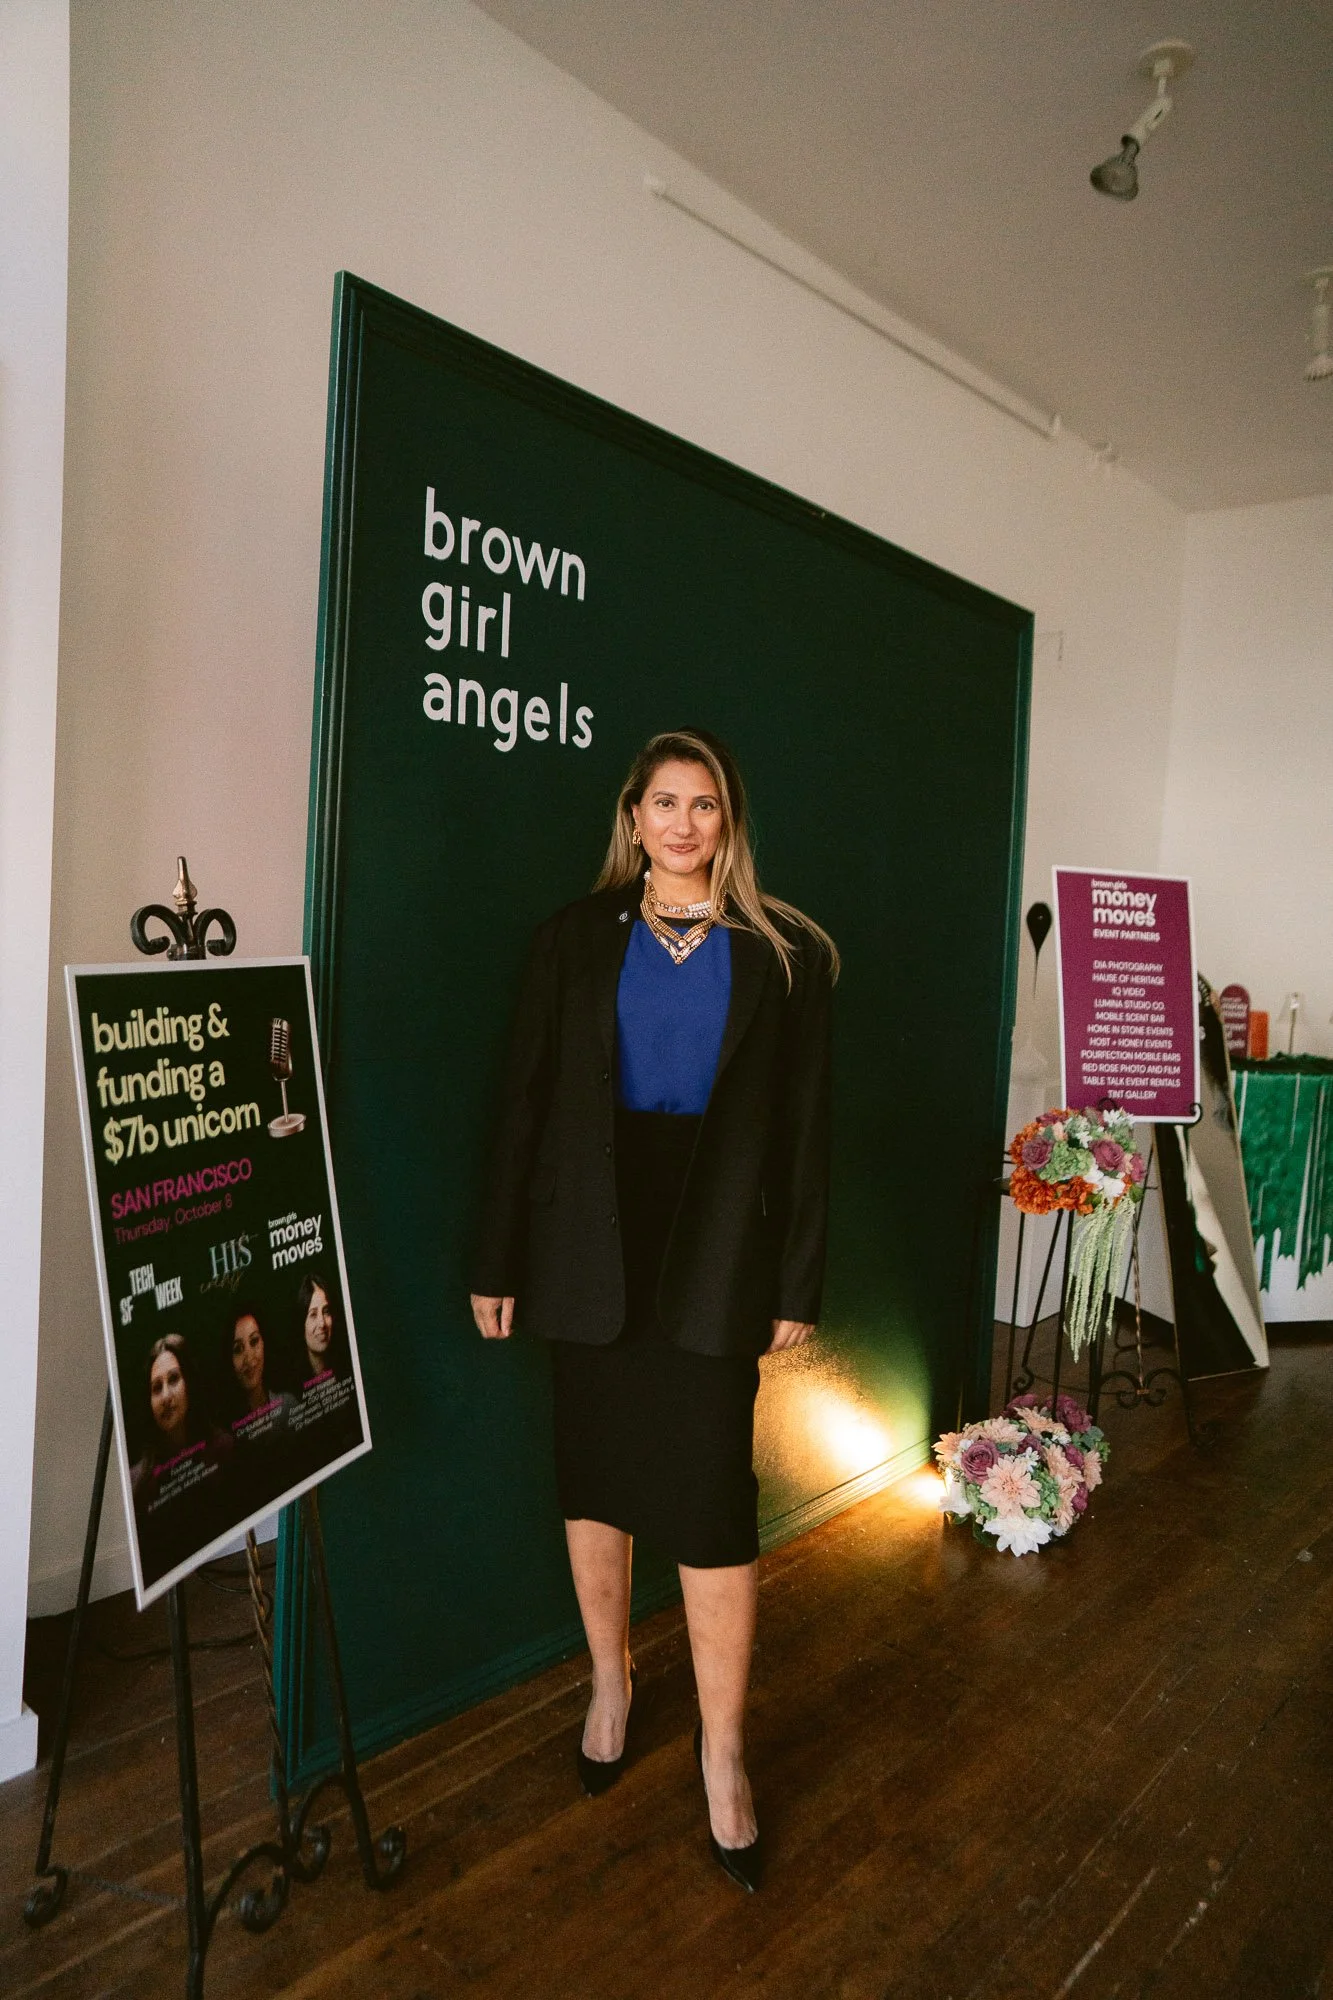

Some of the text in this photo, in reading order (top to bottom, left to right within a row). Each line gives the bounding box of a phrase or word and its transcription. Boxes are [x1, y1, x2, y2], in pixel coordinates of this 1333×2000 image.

[424, 486, 586, 601] brown
[421, 581, 511, 658] girl
[422, 672, 594, 752] angels
[1091, 889, 1157, 912] money
[1093, 907, 1156, 928] moves
[1093, 928, 1161, 942] EVENT PARTNERS
[1108, 961, 1163, 972] PHOTOGRAPHY
[1118, 974, 1130, 984] OF
[1131, 975, 1165, 986] HERITAGE
[1122, 987, 1146, 997] VIDEO
[1094, 998, 1123, 1009] LUMINA
[1124, 1000, 1151, 1010] STUDIO
[91, 1002, 230, 1053] building &
[1095, 1011, 1165, 1023] MOBILE SCENT BAR
[1087, 1024, 1173, 1036] HOME IN STONE EVENTS
[1089, 1037, 1110, 1046] HOST
[1117, 1038, 1144, 1048] HONEY
[1144, 1039, 1172, 1049] EVENTS
[1081, 1049, 1181, 1062] POURFECTION MOBILE BARS
[1082, 1062, 1180, 1075] RED ROSE PHOTO AND FILM
[97, 1057, 225, 1108] funding a
[1082, 1075, 1181, 1088] TABLE TALK EVENT RENTALS
[1107, 1089, 1157, 1099] TINT GALLERY
[103, 1102, 261, 1166] $7b unicorn
[111, 1157, 252, 1219] SAN FRANCISCO
[175, 1200, 222, 1224] October
[268, 1216, 288, 1230] brown
[269, 1214, 322, 1249] money
[272, 1237, 323, 1271] moves
[129, 1263, 155, 1296] TECH
[155, 1276, 183, 1310] WEEK
[120, 1295, 133, 1326] SF
